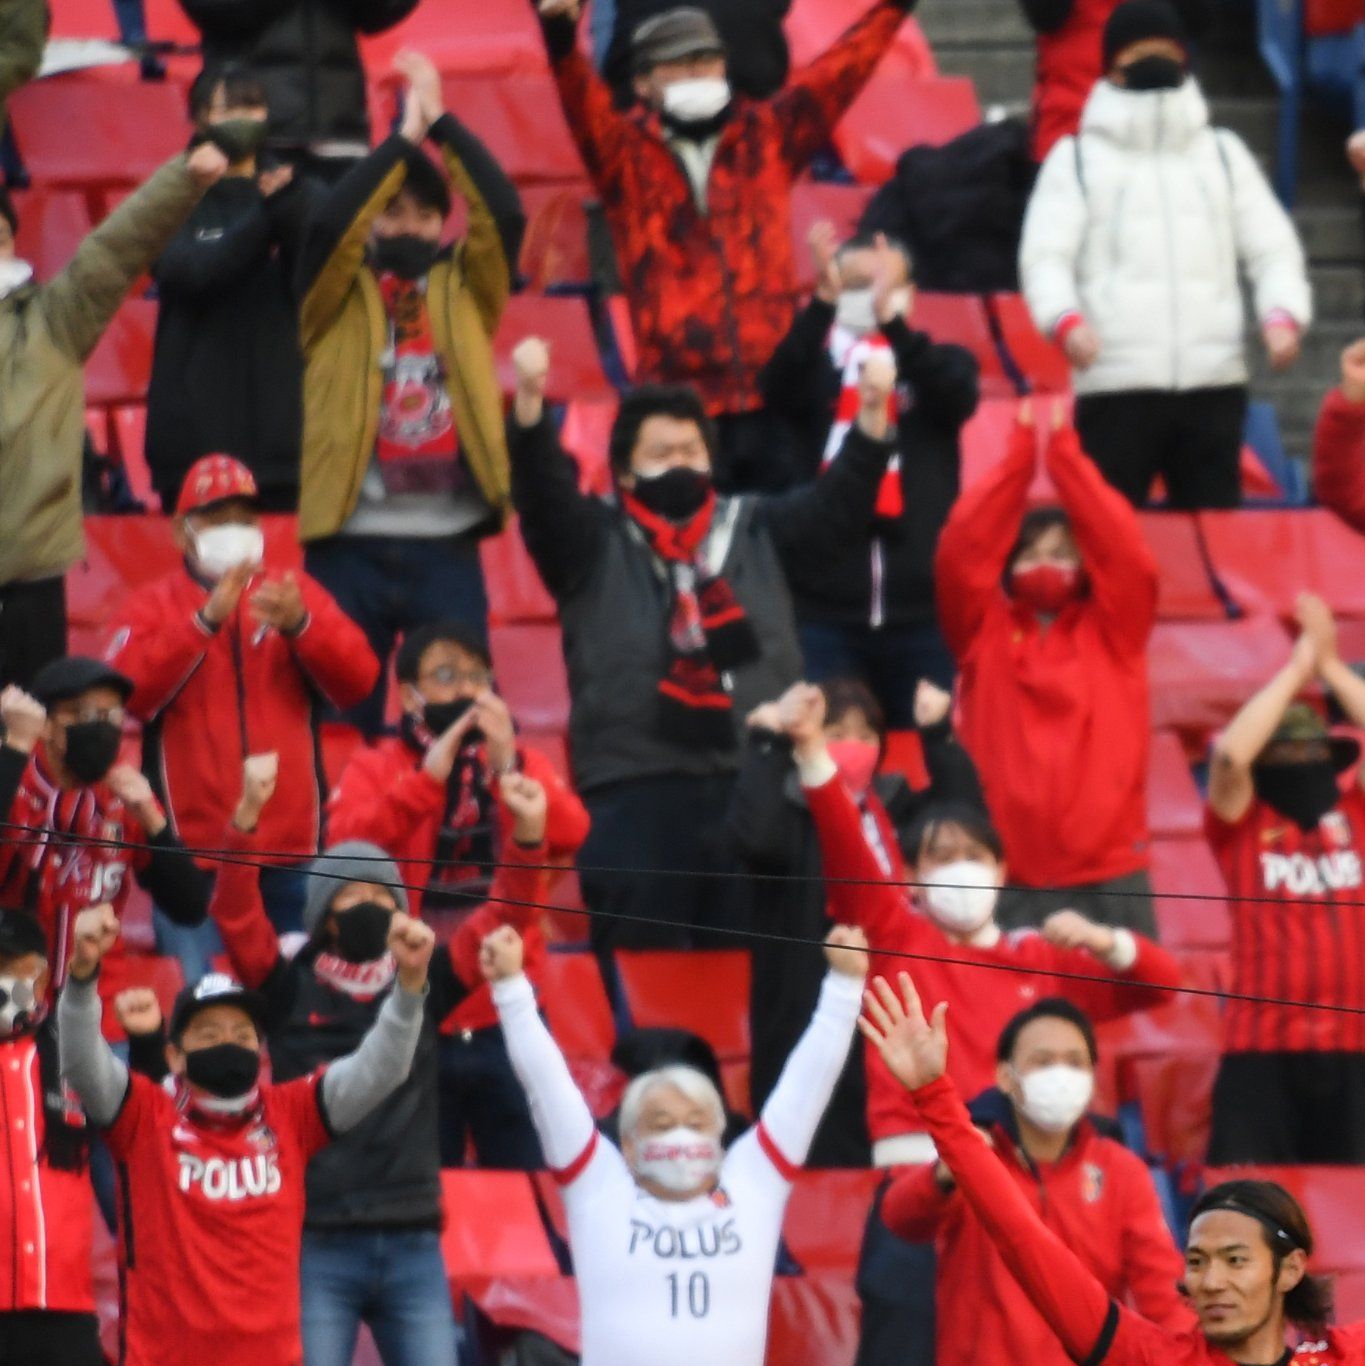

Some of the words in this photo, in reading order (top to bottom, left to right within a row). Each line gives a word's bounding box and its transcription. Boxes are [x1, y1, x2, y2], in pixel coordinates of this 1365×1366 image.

[178, 1152, 282, 1200] POLUS
[628, 1218, 743, 1259] POLUS
[665, 1270, 711, 1319] 10
